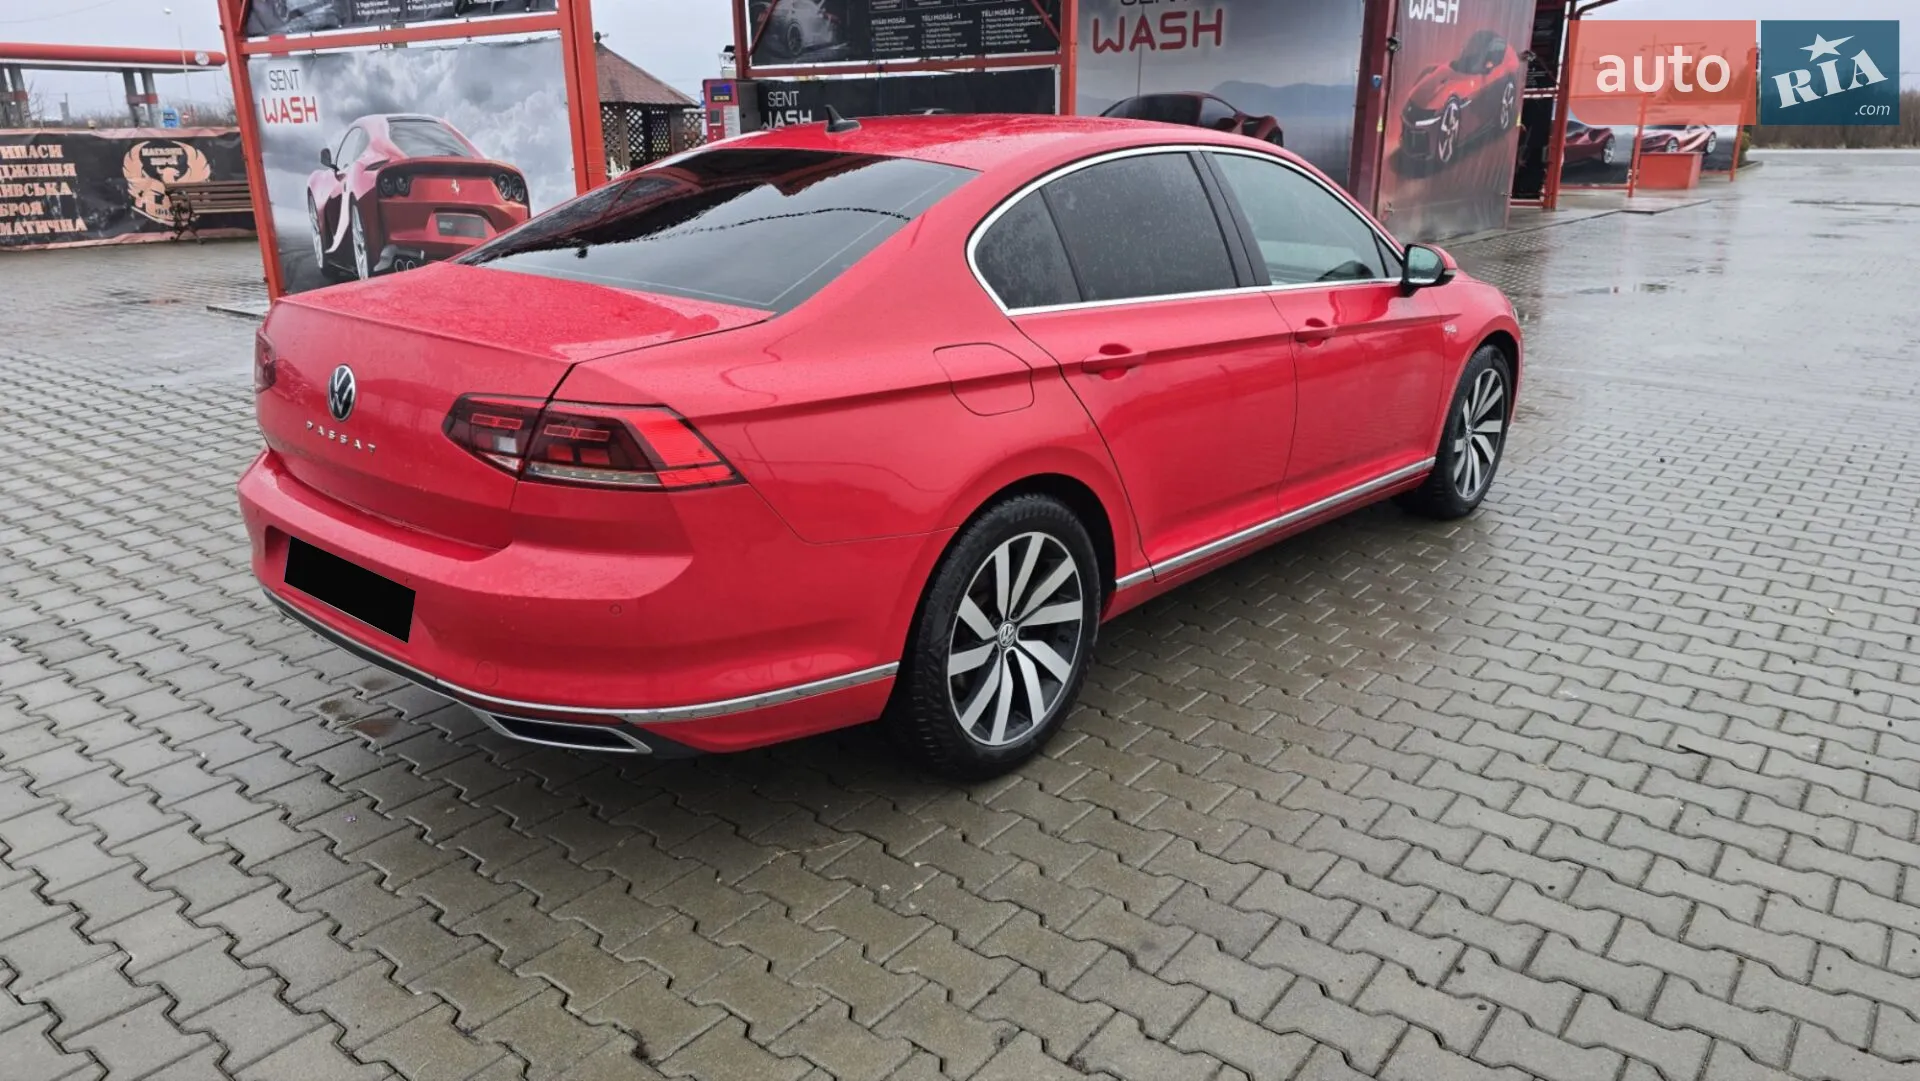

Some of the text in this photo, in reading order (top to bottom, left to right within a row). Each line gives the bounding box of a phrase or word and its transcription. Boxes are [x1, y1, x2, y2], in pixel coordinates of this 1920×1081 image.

[1408, 0, 1460, 25] WASH
[1092, 8, 1223, 54] WASH
[268, 68, 300, 91] SENT
[261, 95, 319, 124] WASH
[767, 90, 799, 107] SENT
[0, 182, 73, 198] ИВСЬКА
[306, 420, 376, 453] PASSAT
